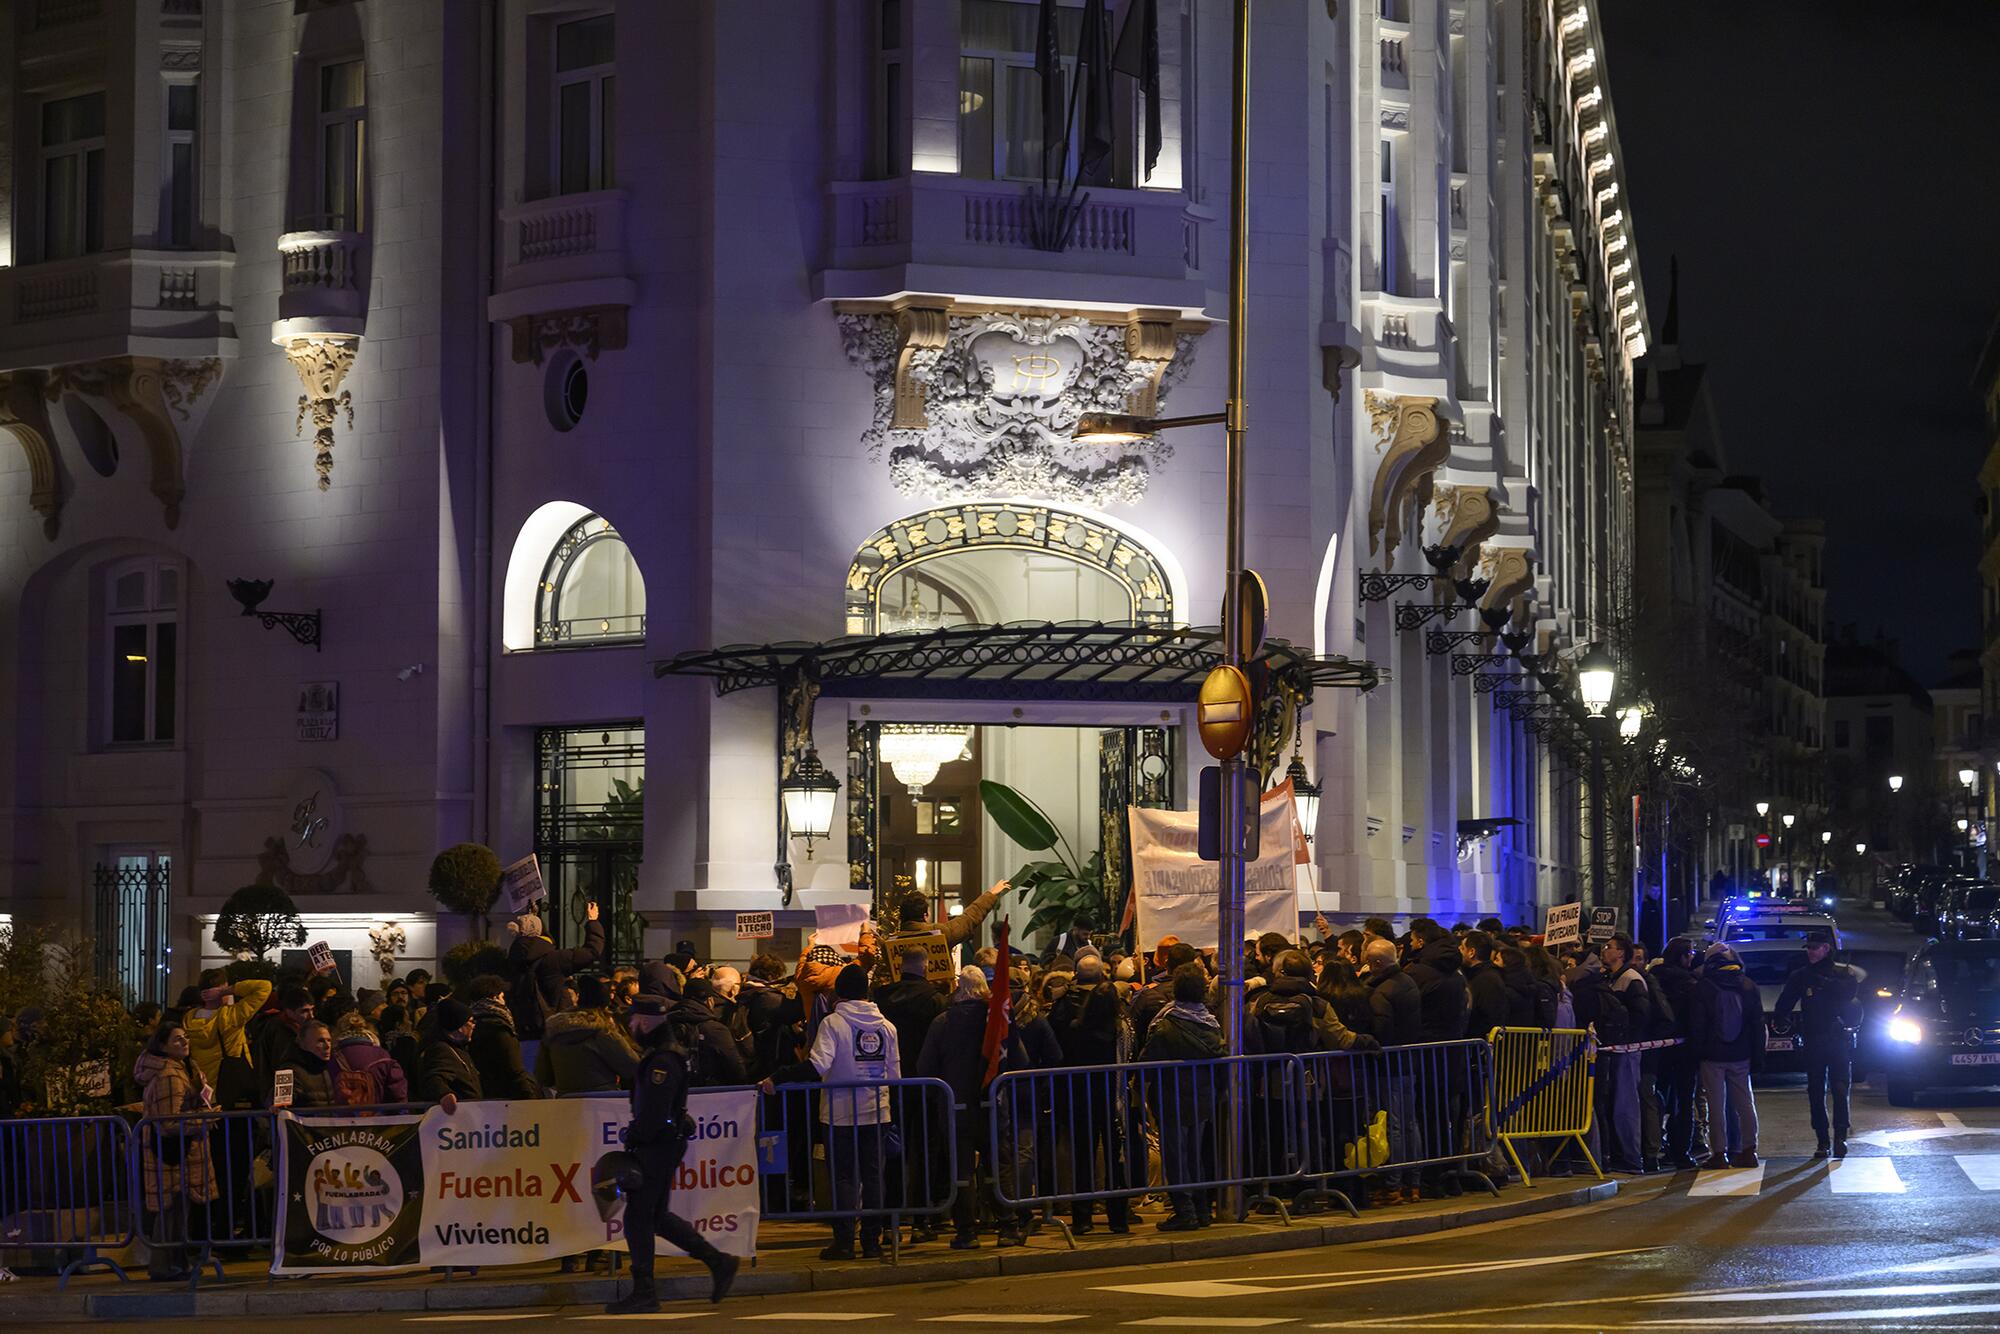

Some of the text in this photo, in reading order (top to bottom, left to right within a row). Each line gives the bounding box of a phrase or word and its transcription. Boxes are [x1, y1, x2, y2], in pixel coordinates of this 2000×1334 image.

[737, 913, 772, 924] DERECHO
[1561, 906, 1579, 922] FRAUDE
[1596, 911, 1612, 923] STOP
[738, 922, 772, 933] A TECHO
[930, 943, 946, 954] con
[308, 1131, 395, 1156] FUENLABRADA
[437, 1123, 540, 1150] Sanidad
[439, 1168, 543, 1199] Fuenla
[550, 1163, 583, 1204] X
[435, 1221, 550, 1246] Vivienda
[310, 1237, 395, 1262] POR LO PÚBLICO
